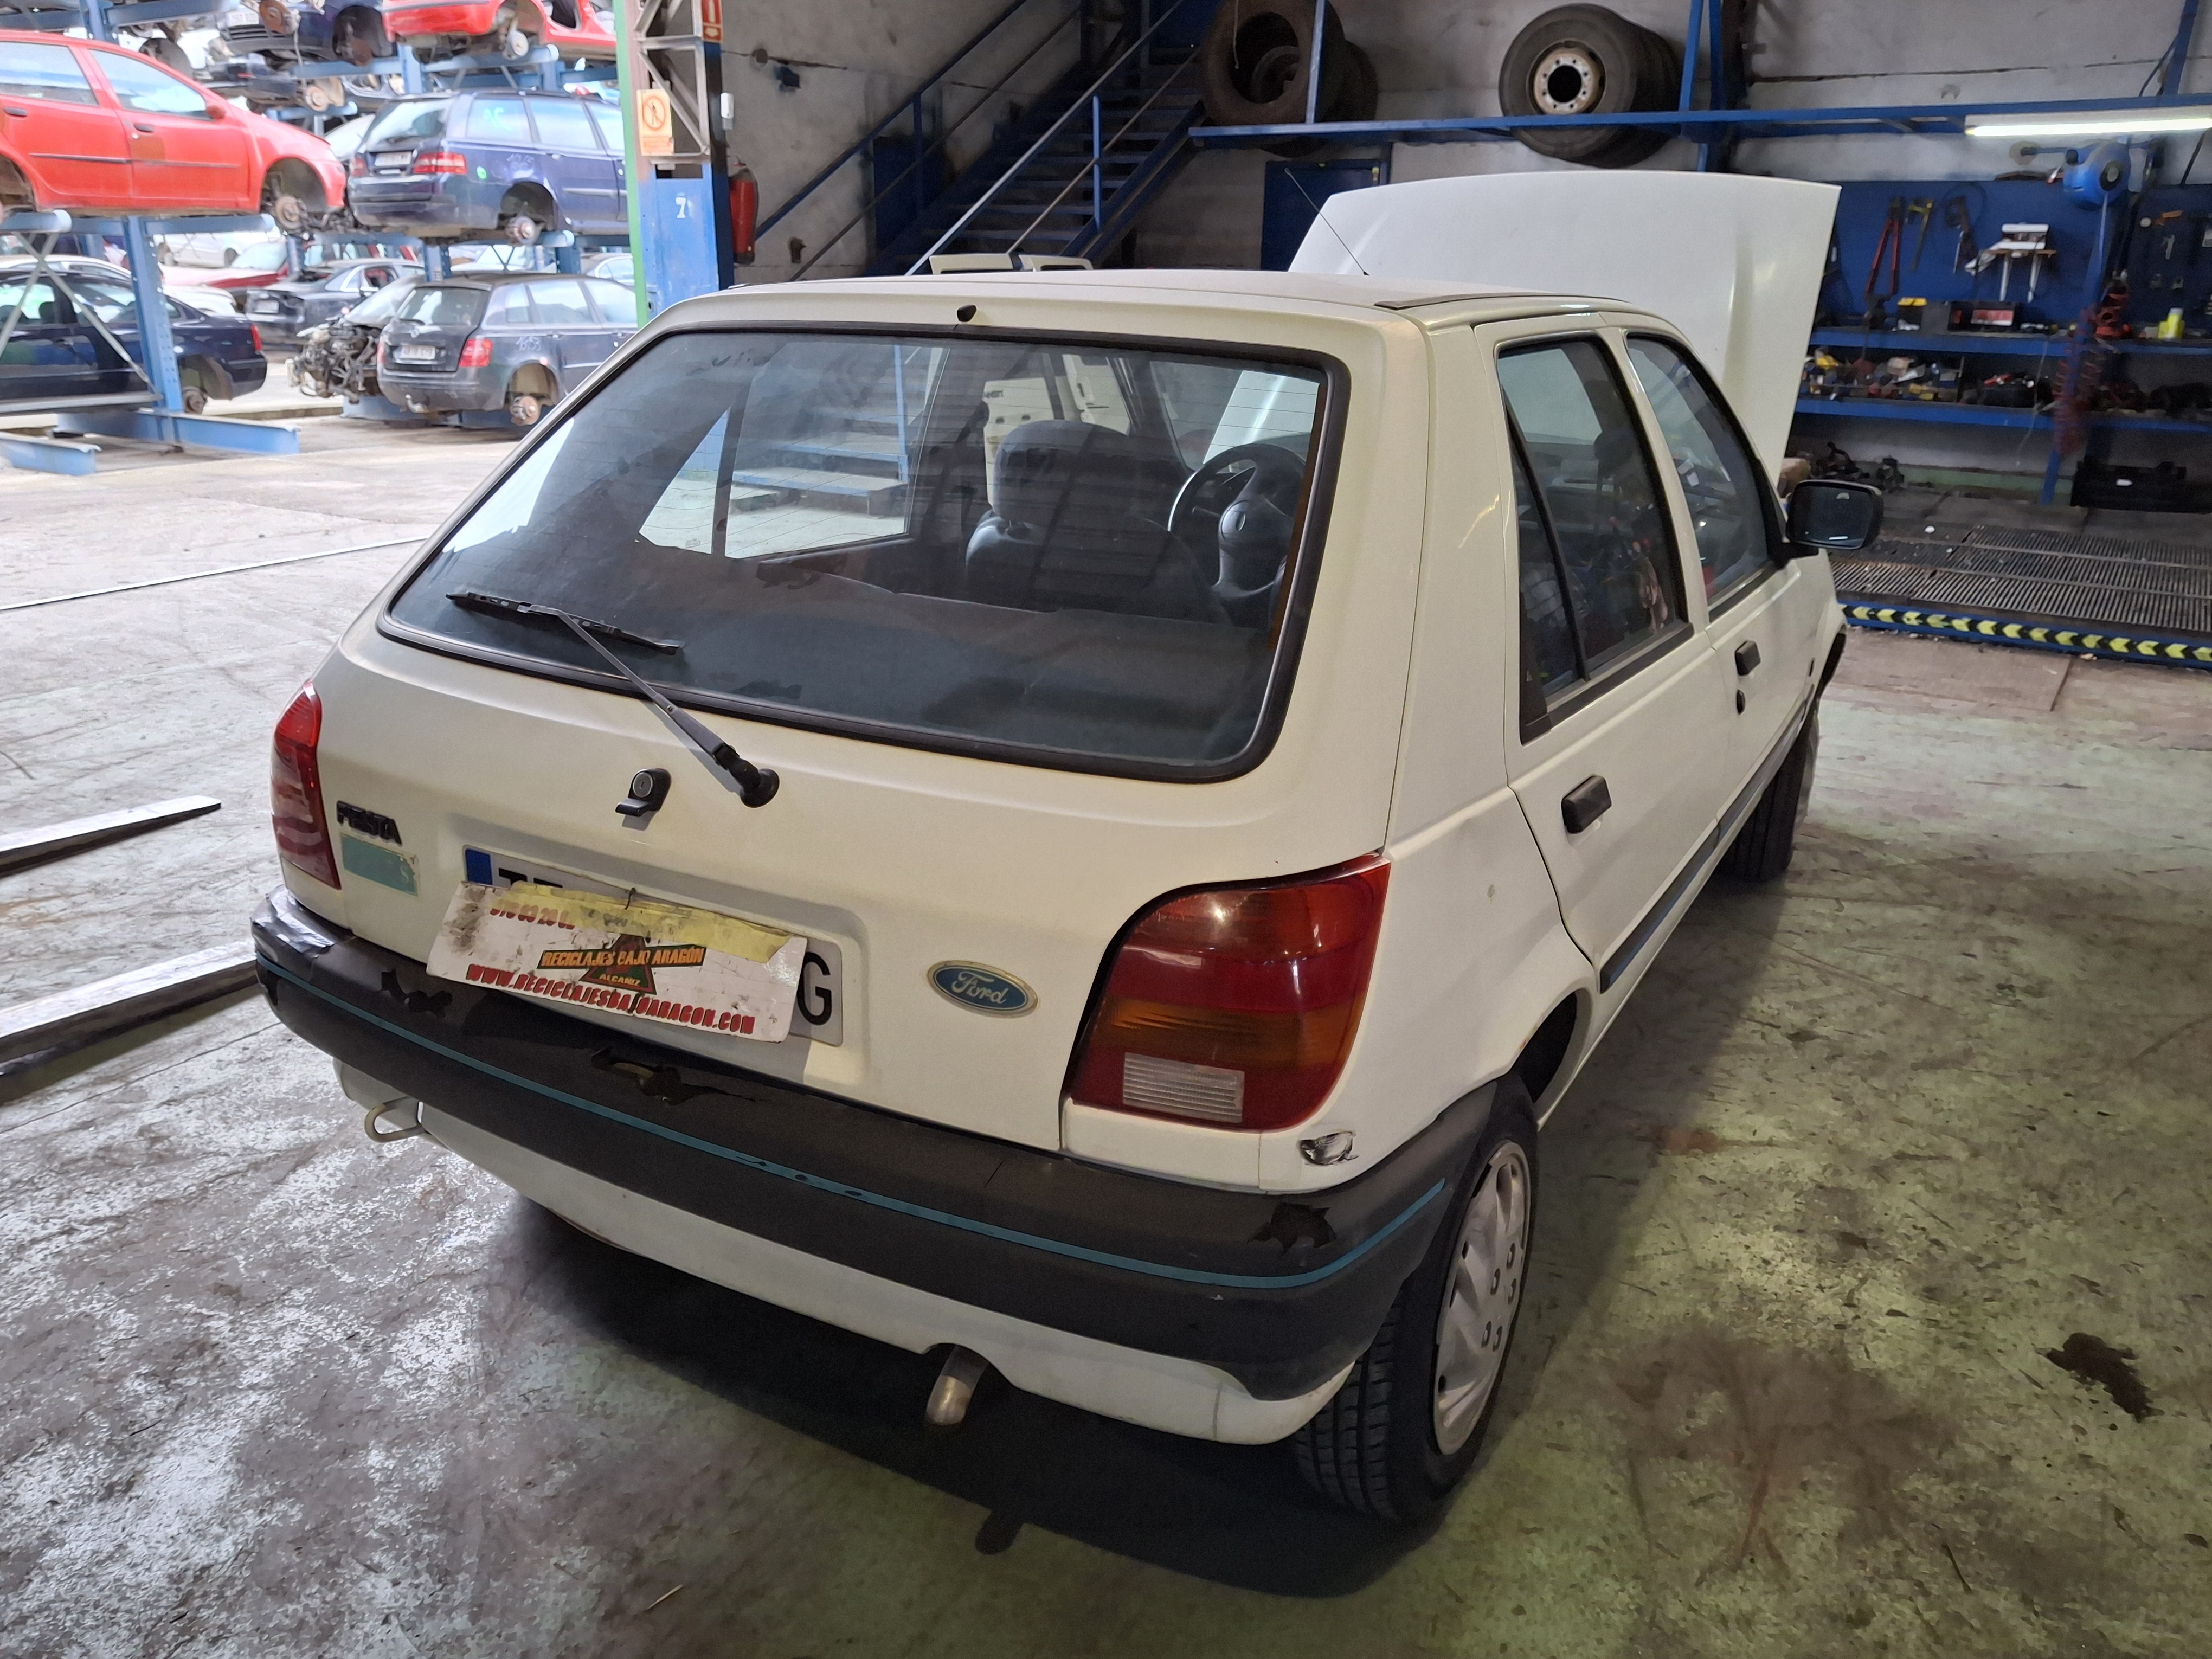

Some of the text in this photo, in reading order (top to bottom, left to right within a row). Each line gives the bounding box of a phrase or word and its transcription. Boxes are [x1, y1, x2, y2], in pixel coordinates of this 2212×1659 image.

[541, 951, 616, 967] RECICLAJES
[617, 949, 651, 966] BAJO
[796, 952, 832, 1026] G
[950, 971, 1009, 1004] Ford
